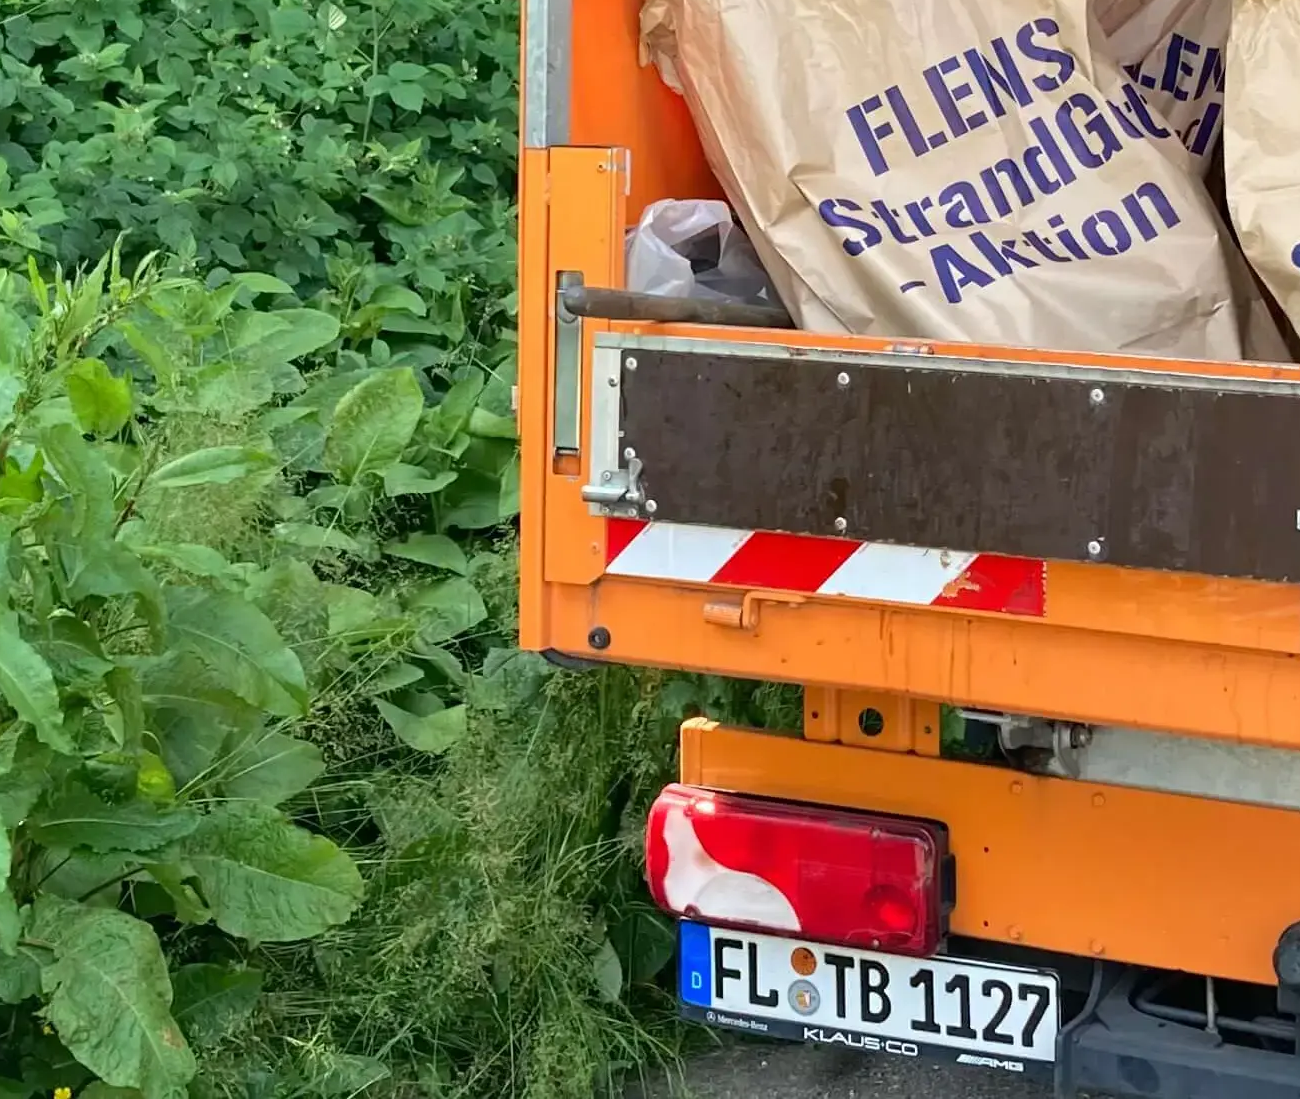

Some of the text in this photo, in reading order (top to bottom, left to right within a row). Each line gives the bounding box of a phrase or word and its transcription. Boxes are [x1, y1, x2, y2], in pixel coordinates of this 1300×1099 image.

[845, 17, 1075, 177] FLENS
[1123, 32, 1226, 101] LEN
[691, 971, 703, 989] D
[714, 938, 1051, 1049] FL TB 1127
[717, 1013, 769, 1032] Mercedes-Benz
